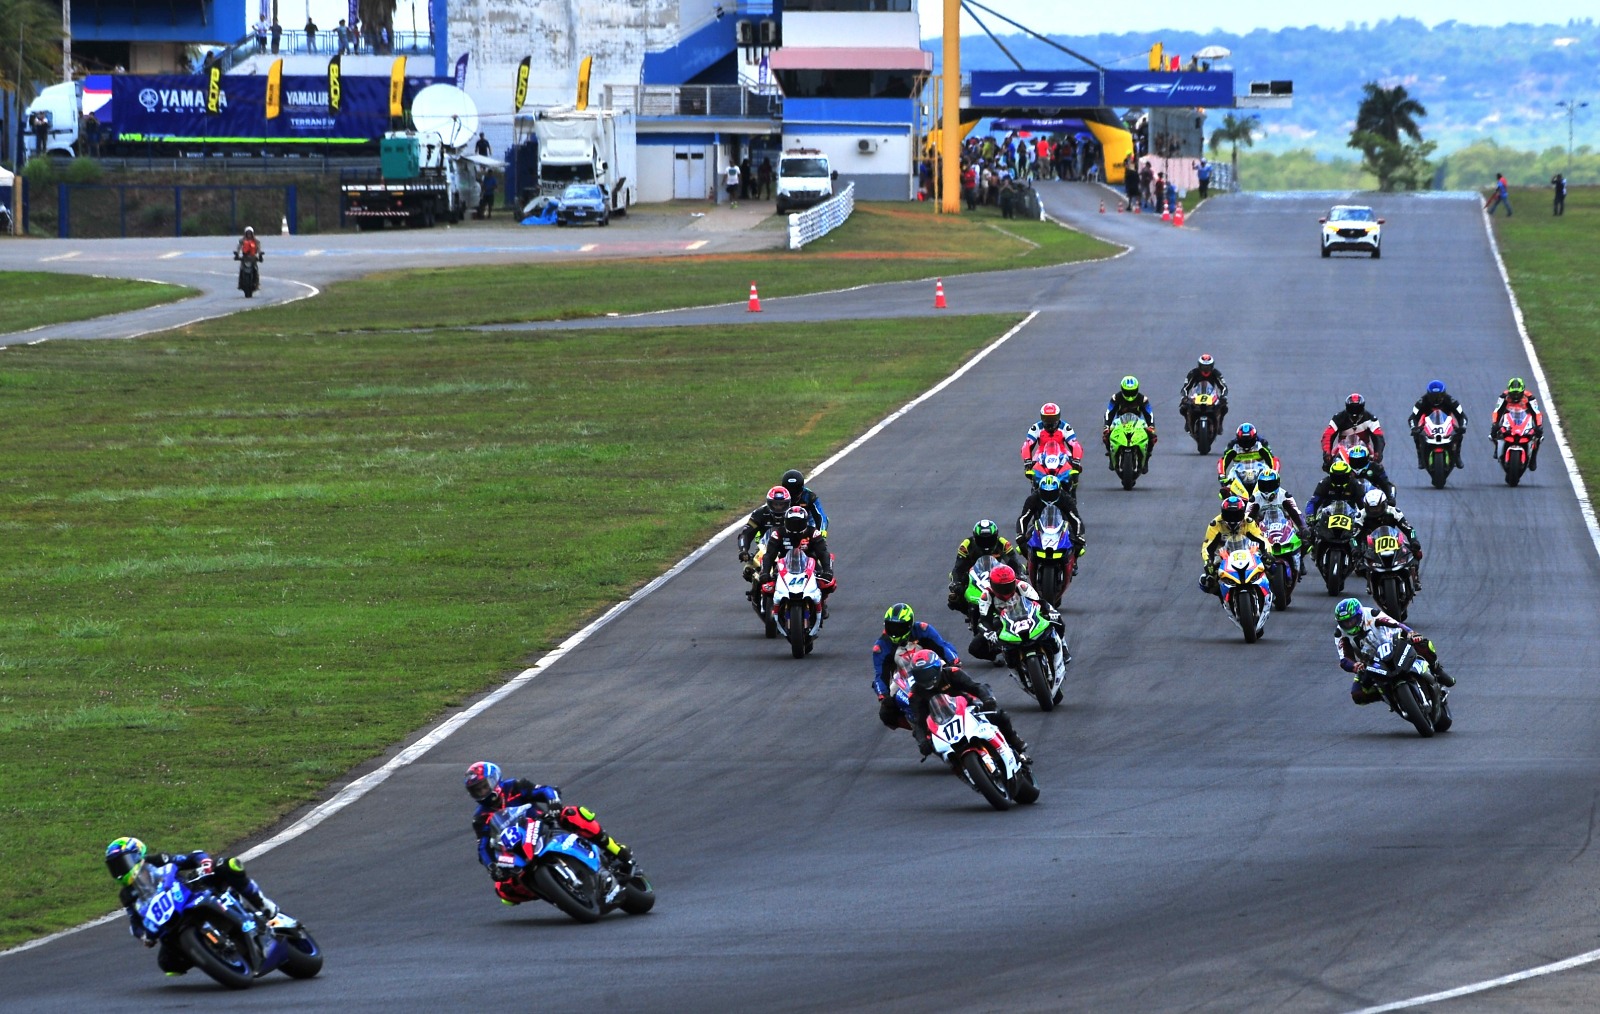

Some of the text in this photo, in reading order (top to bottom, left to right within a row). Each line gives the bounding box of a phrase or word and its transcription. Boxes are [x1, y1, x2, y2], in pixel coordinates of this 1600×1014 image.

[159, 89, 228, 107] YAMAA
[1331, 516, 1349, 527] 28
[1377, 537, 1396, 550] 100
[788, 576, 805, 586] 44
[943, 719, 962, 742] 177
[151, 893, 173, 922] 80
